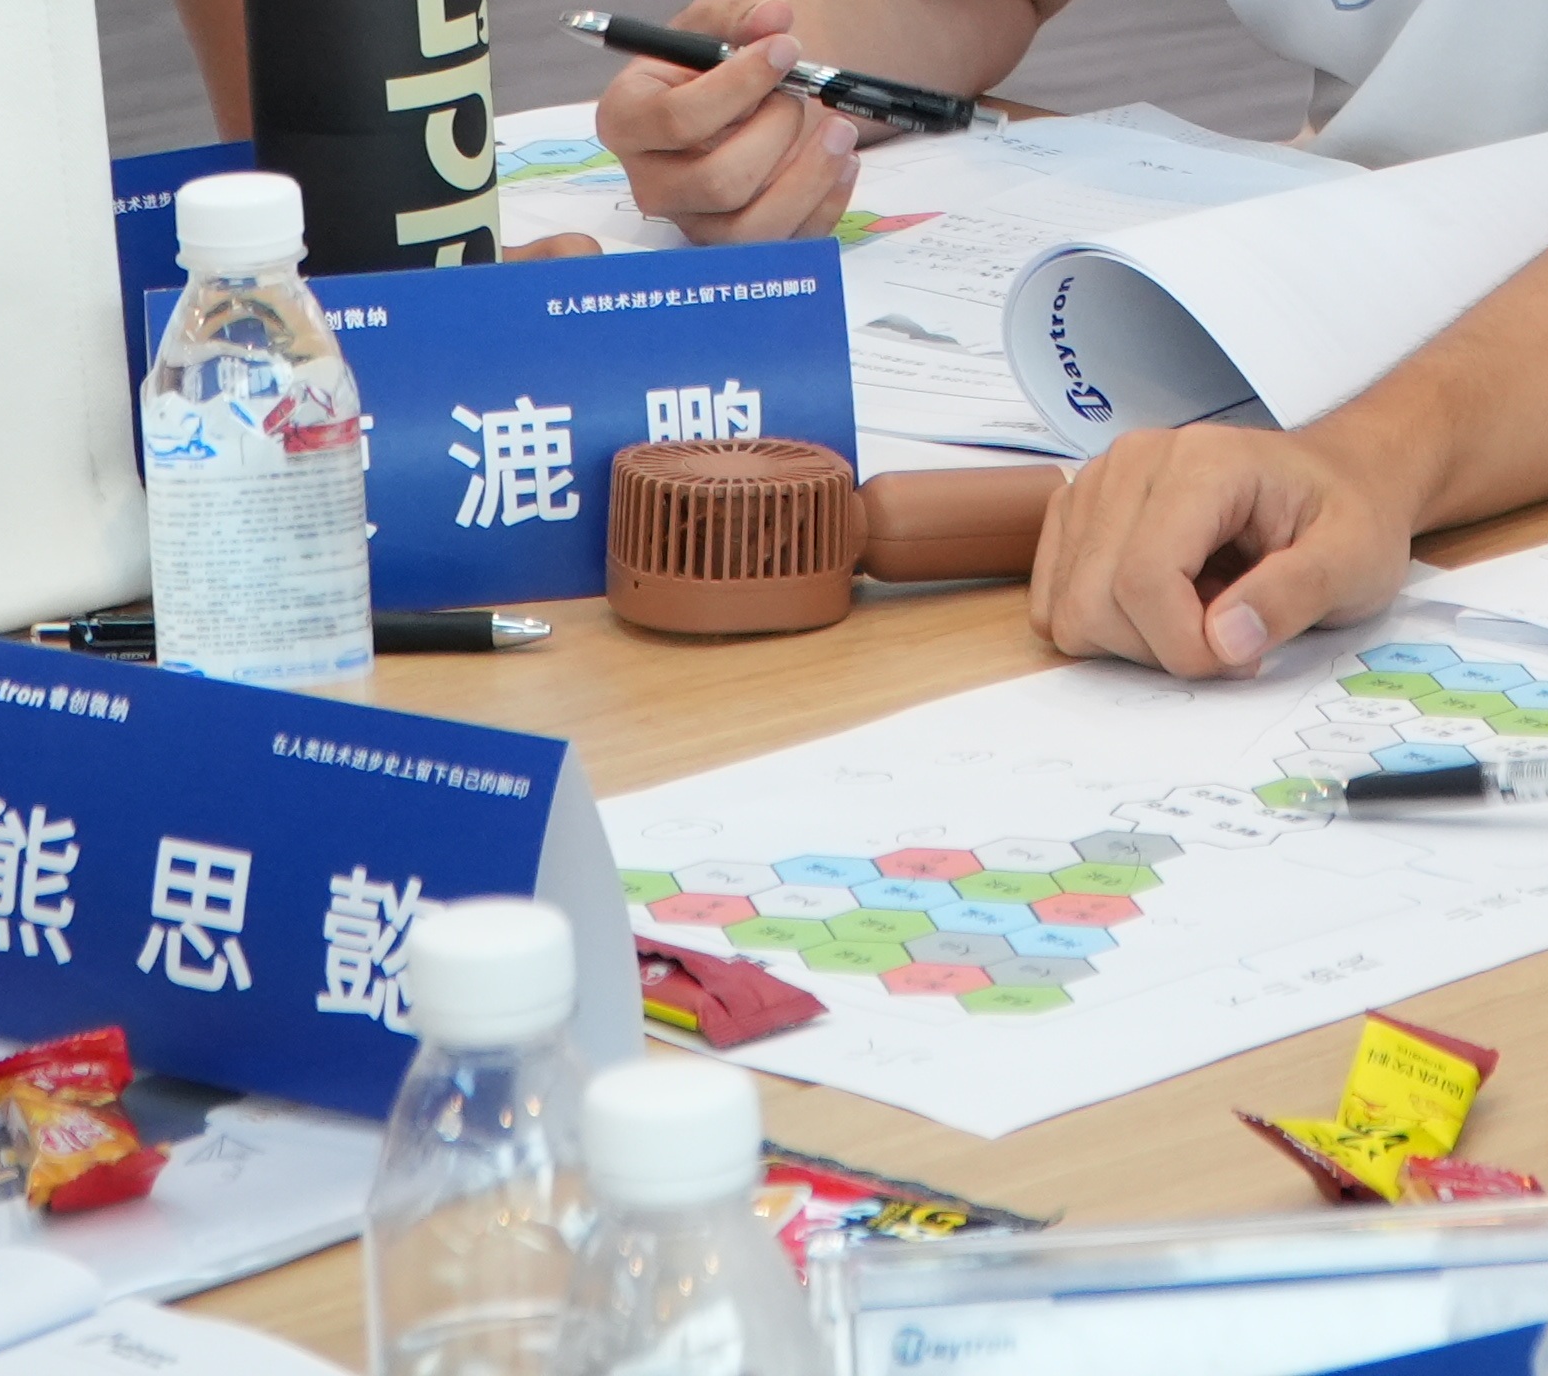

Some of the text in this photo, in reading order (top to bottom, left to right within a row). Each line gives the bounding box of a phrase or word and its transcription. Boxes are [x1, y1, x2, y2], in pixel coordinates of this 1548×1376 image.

[546, 277, 817, 317] 在人类技术进步史上留下自己的脚印
[271, 732, 532, 800] 在人类技术进步史上留下自己的脚印
